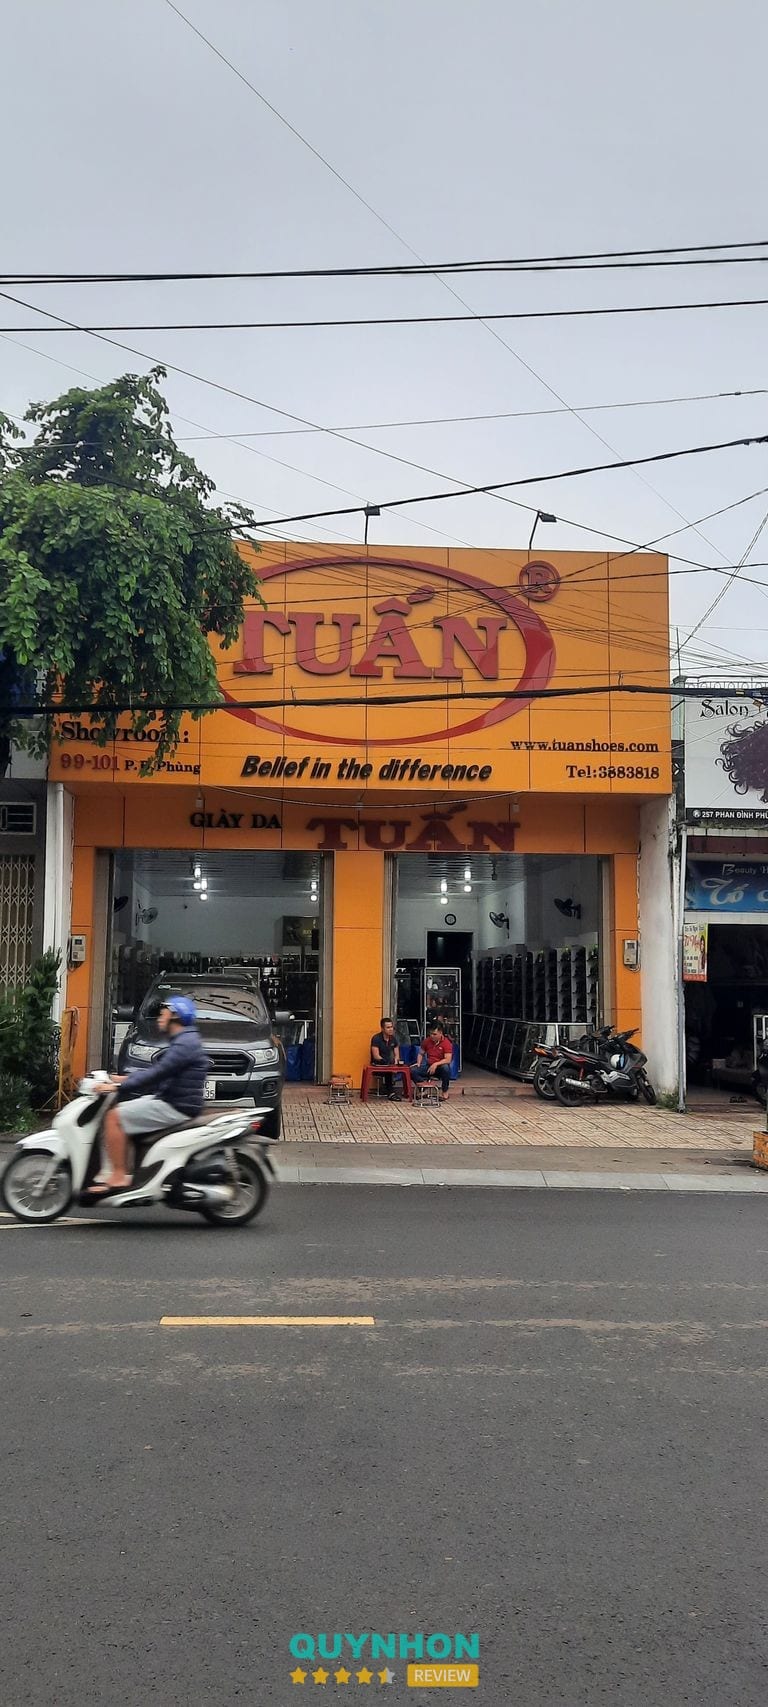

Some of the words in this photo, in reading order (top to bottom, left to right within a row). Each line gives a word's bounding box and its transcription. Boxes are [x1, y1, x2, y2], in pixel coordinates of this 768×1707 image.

[233, 585, 507, 680] TUẤN
[700, 699, 749, 718] Salon
[61, 720, 189, 743] Shoroo:
[510, 738, 659, 752] www.tuanshoes.com
[60, 753, 120, 771] 99-101
[240, 755, 311, 779] Belief
[309, 757, 332, 779] in
[337, 757, 373, 780] the
[379, 758, 493, 781] difference
[565, 765, 660, 780] Tel:3883818
[190, 808, 244, 829] GIÀY
[252, 813, 283, 829] DA
[715, 811, 735, 819] PHAN
[305, 804, 521, 852] TUẤN
[722, 863, 757, 876] Beauty
